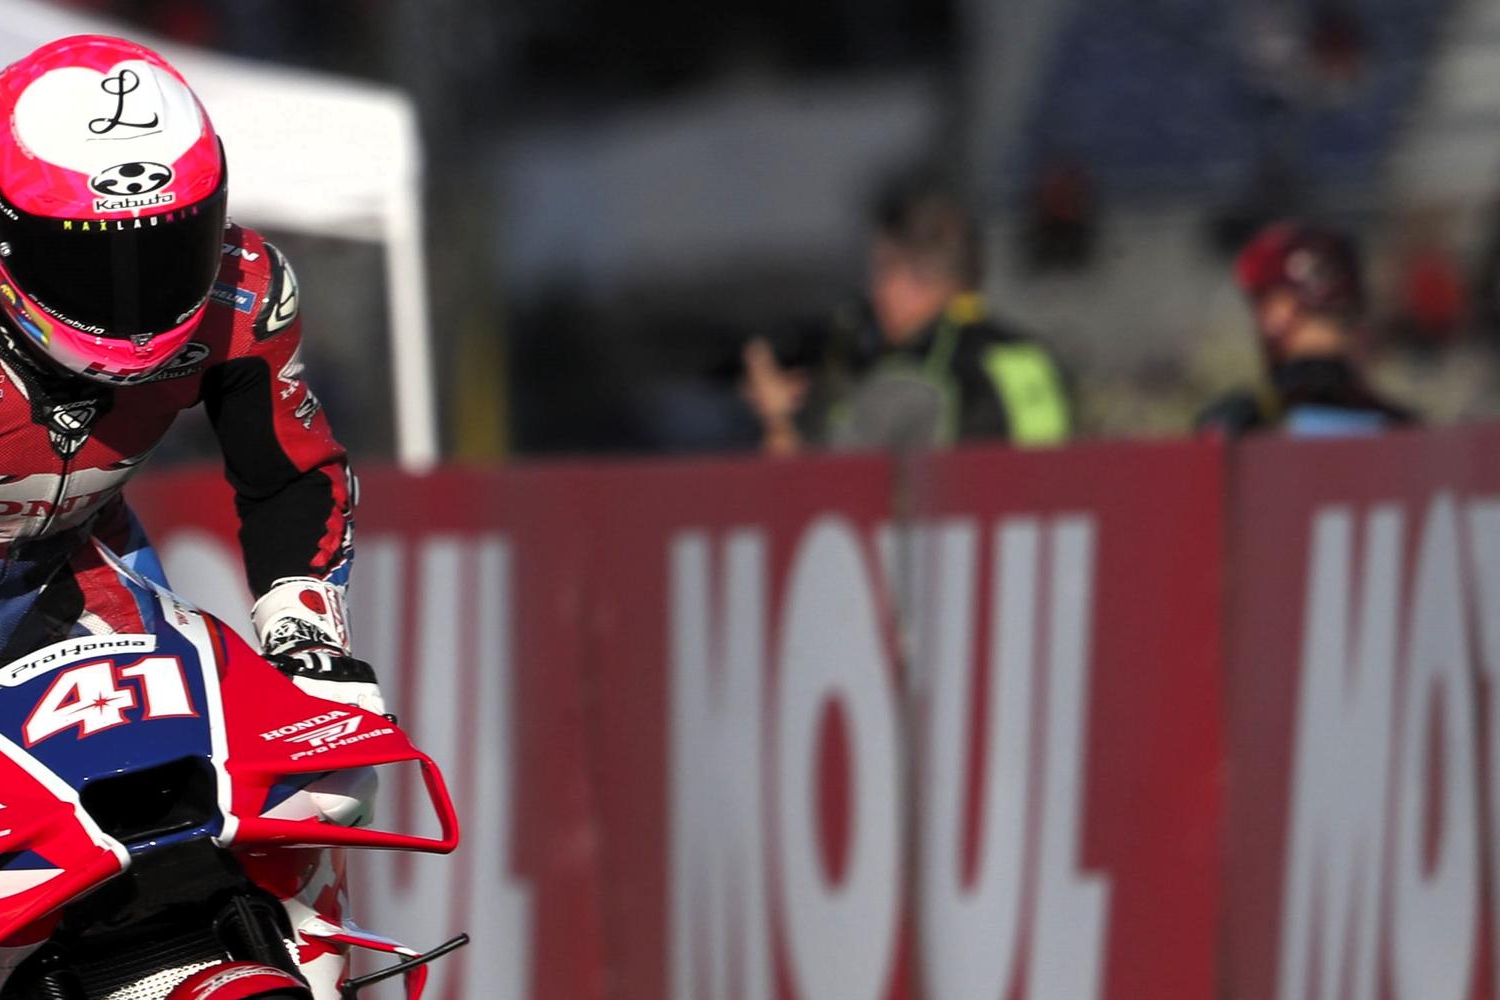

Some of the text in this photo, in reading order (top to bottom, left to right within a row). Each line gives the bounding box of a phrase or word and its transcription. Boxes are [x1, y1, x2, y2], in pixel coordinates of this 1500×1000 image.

[96, 194, 174, 212] Kabuto
[21, 655, 200, 749] 41
[258, 710, 351, 741] HONDA
